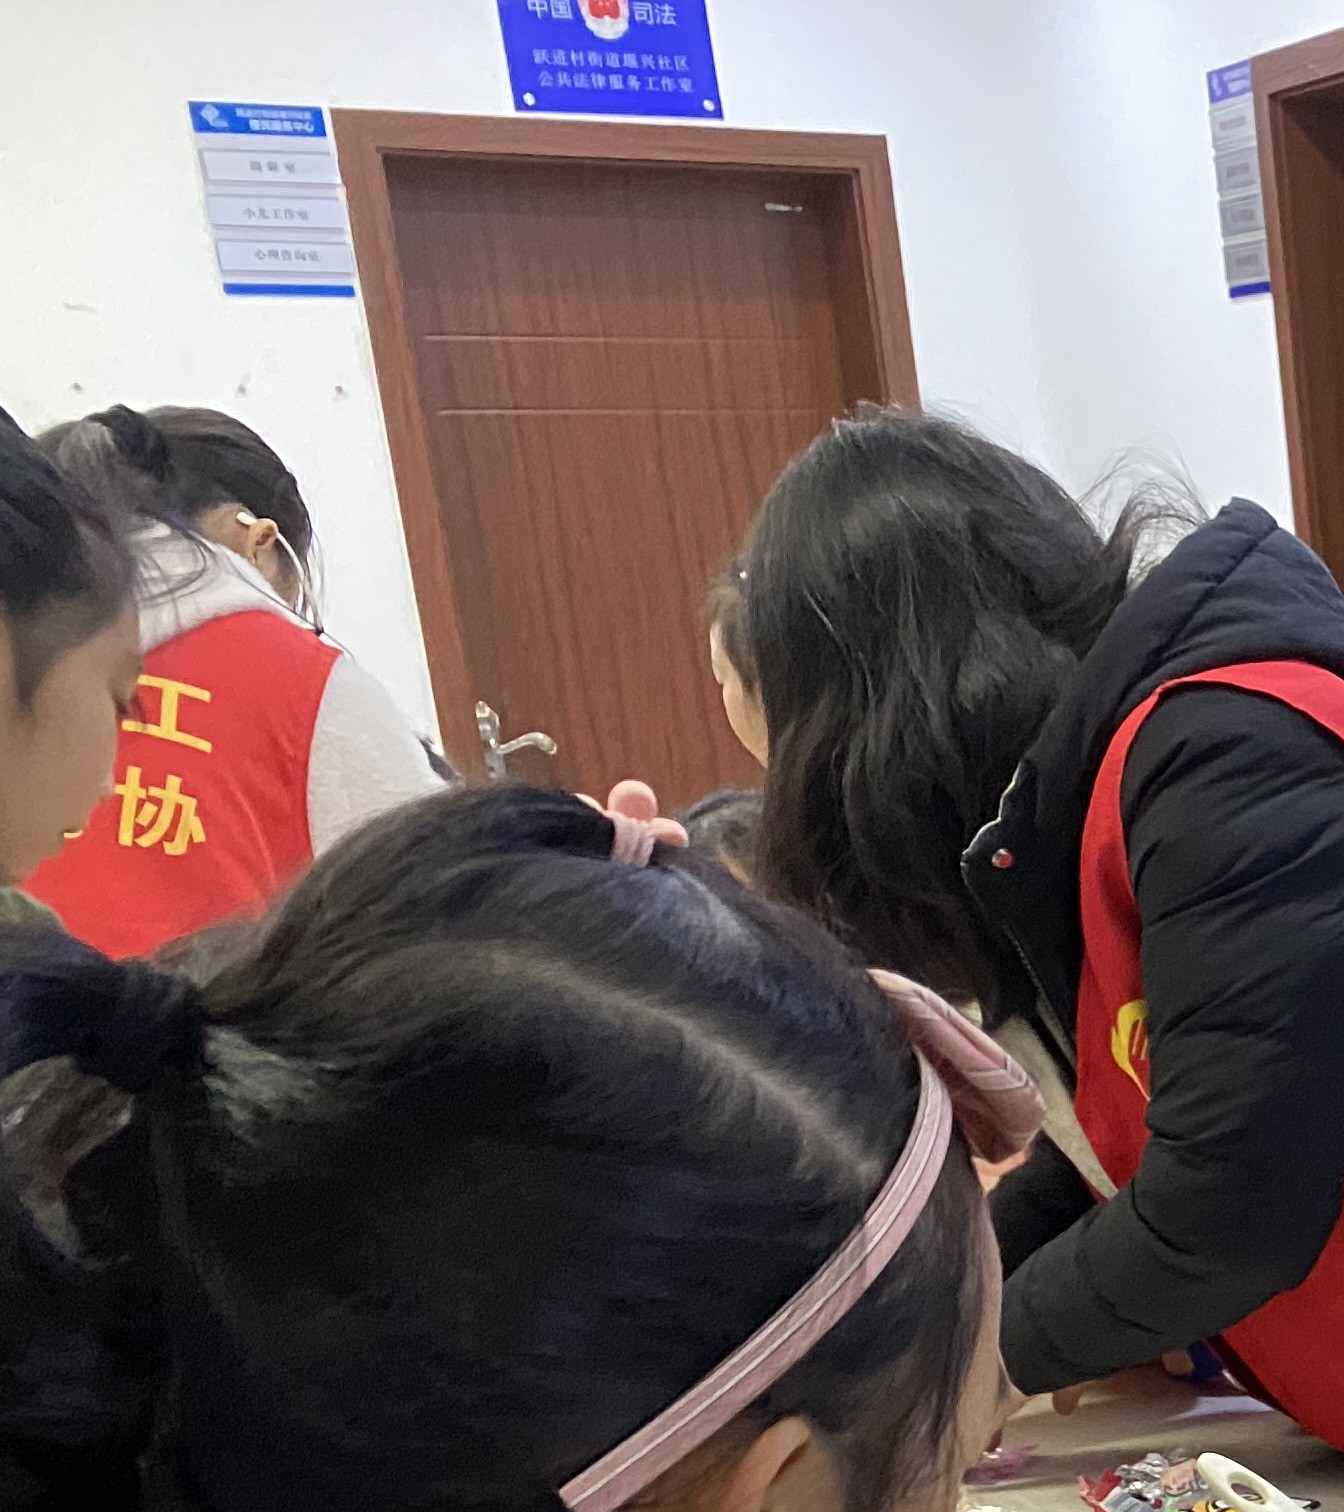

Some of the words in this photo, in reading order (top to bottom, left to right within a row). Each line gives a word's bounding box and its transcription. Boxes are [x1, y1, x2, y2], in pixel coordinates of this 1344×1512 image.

[527, 0, 573, 20] 中国
[632, 1, 678, 26] 司法
[122, 674, 213, 753] 工
[114, 766, 206, 856] 协
